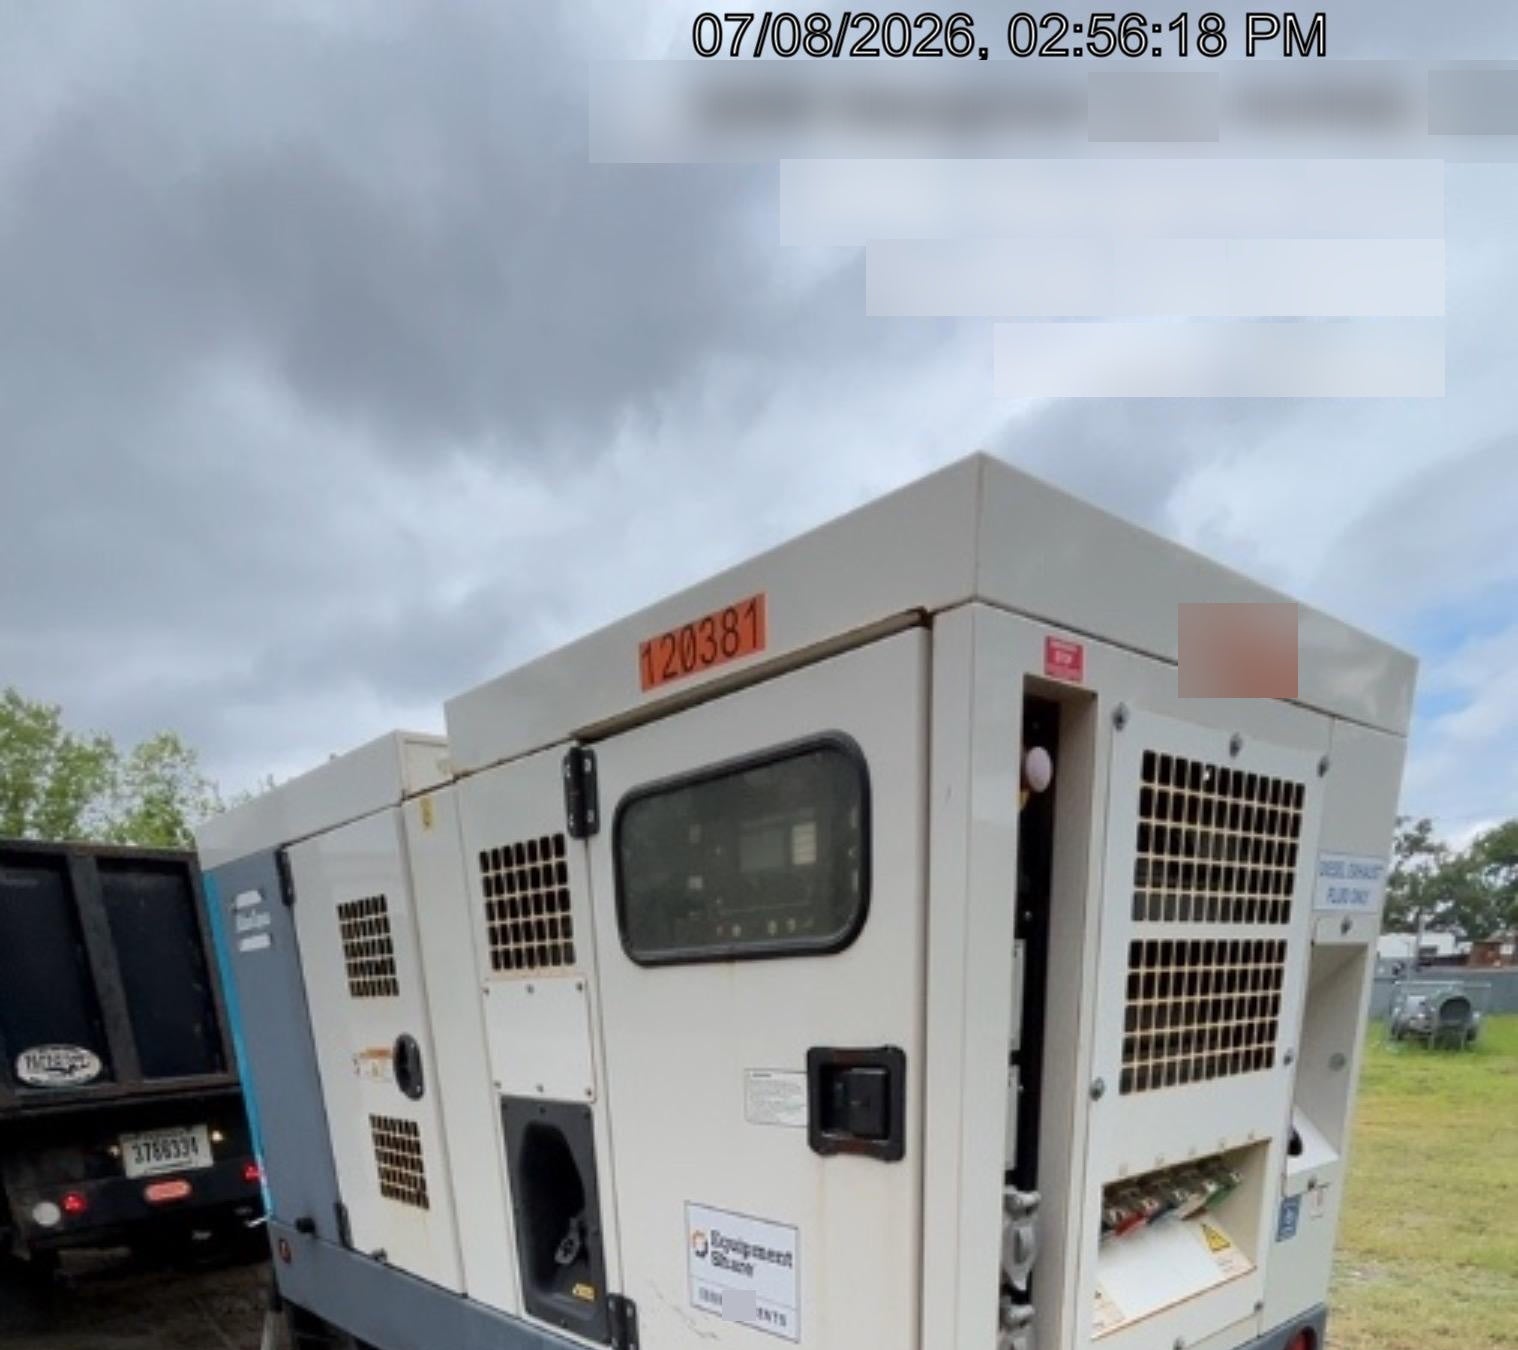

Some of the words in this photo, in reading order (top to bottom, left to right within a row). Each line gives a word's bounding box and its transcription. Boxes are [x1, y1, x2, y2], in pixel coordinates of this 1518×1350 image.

[641, 597, 758, 685] 120381
[710, 1229, 793, 1269] Equipment
[710, 1250, 754, 1278] Share
